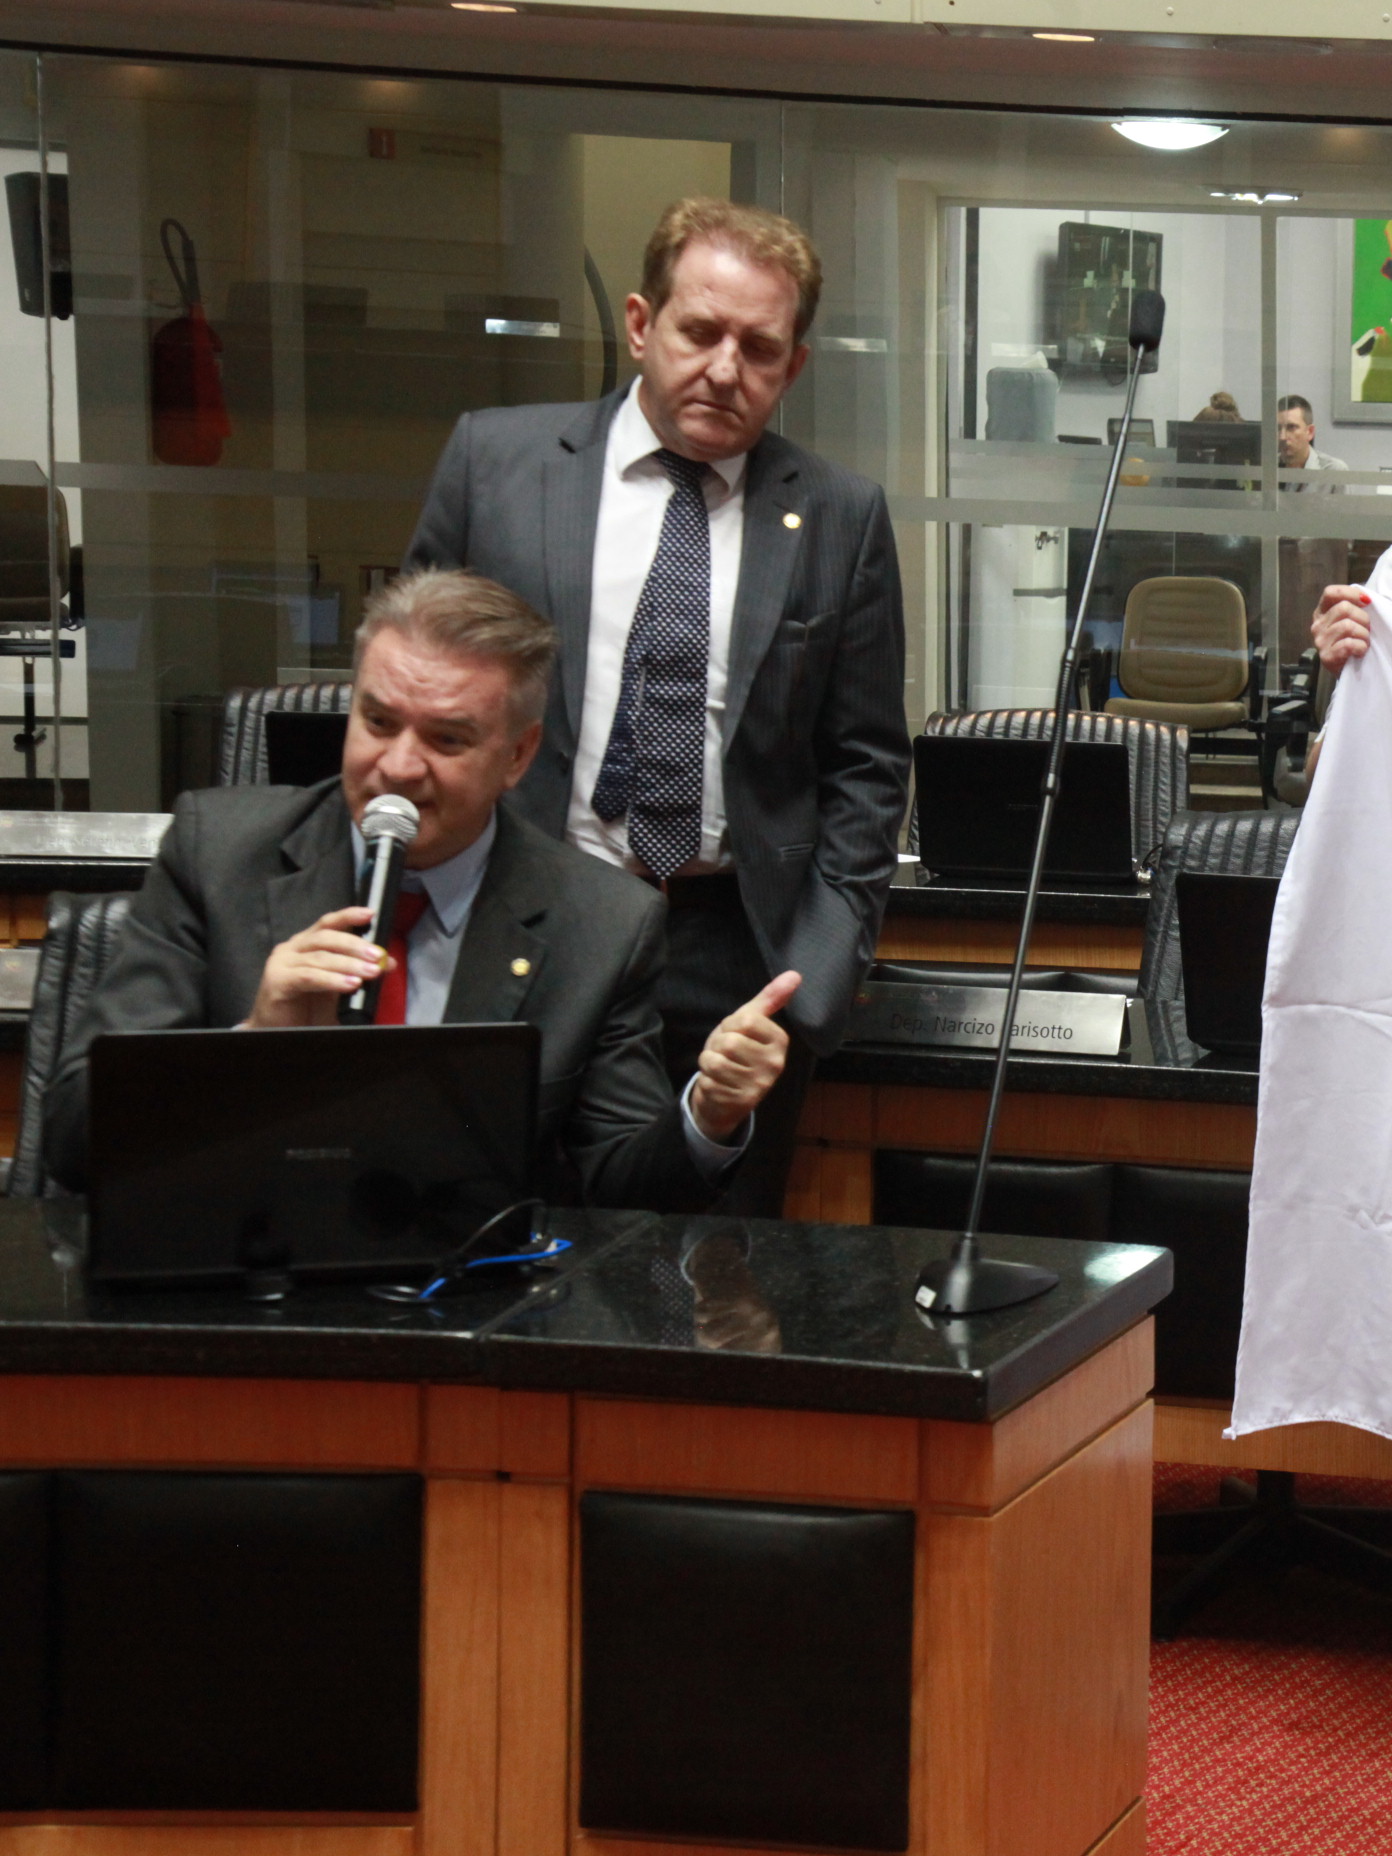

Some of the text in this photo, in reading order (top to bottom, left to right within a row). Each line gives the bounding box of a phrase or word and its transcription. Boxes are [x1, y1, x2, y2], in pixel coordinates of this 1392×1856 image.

[890, 1014, 1074, 1041] Dep. Narcizo arisotto
